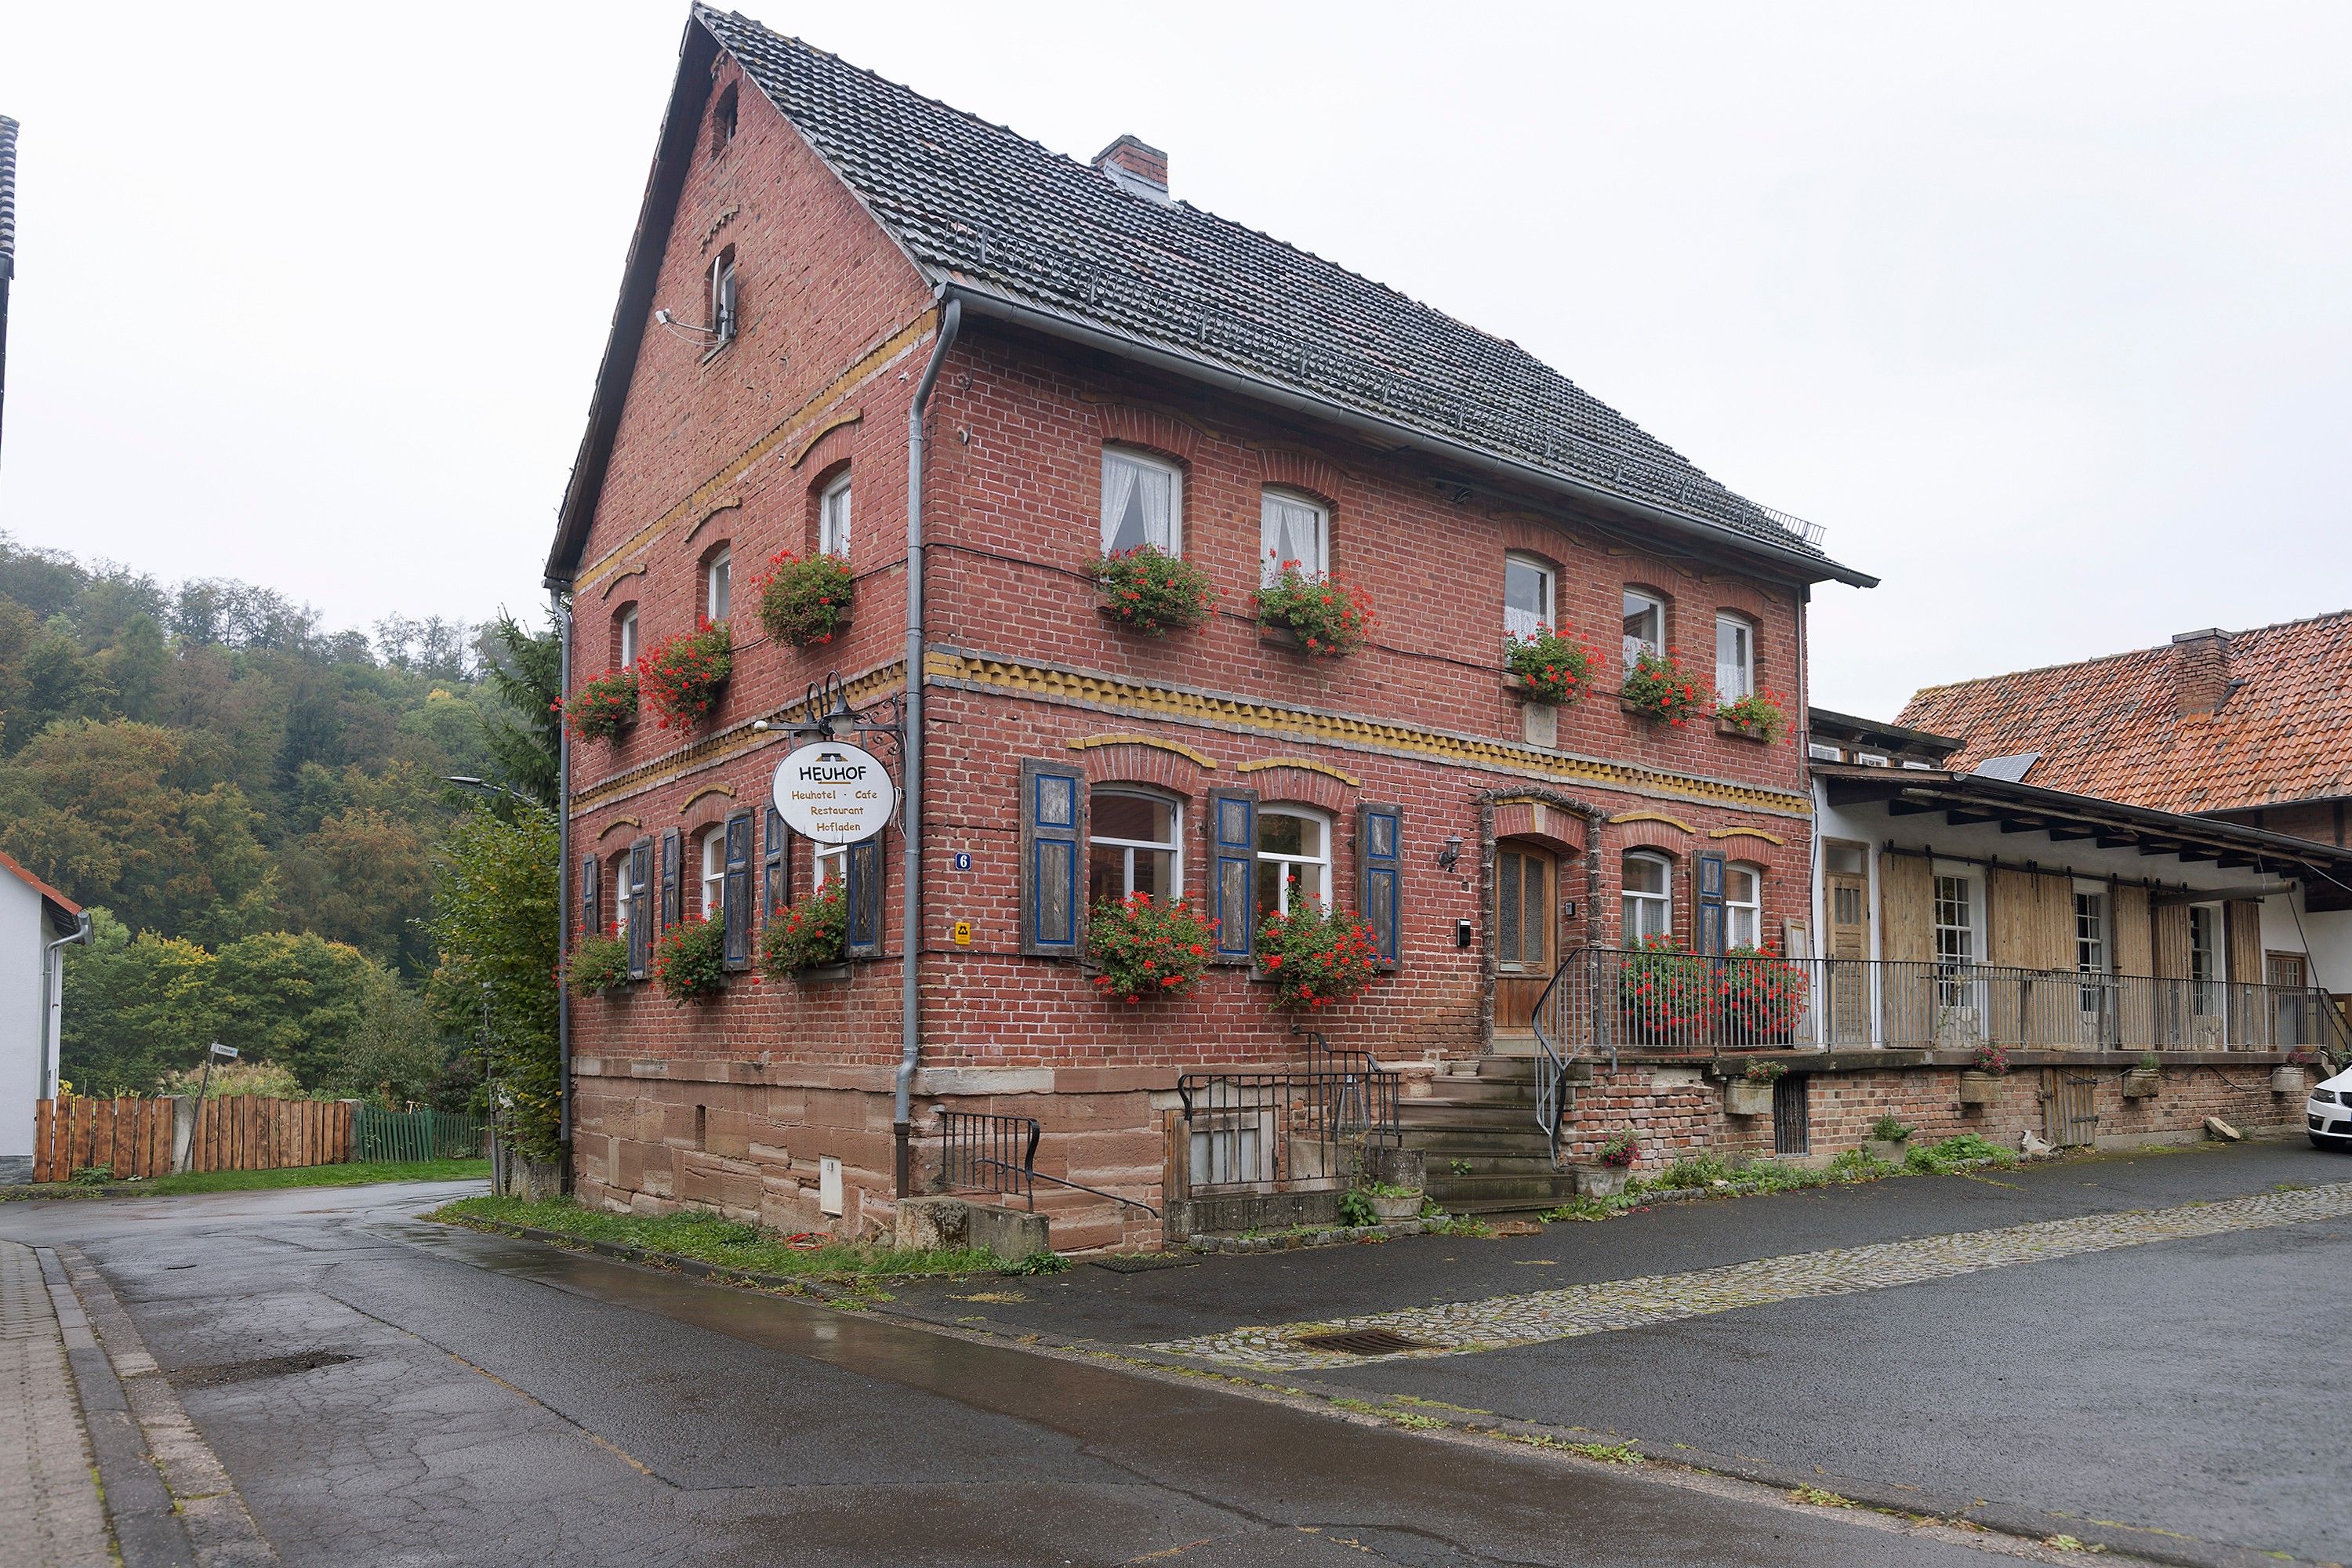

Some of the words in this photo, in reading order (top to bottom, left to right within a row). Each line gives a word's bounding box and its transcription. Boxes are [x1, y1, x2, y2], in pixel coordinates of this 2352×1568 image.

[800, 766, 866, 781] HEUHOF
[792, 790, 836, 800] Heuhotel
[855, 790, 877, 799] Cafe
[810, 806, 864, 815] Restaurant
[816, 822, 861, 832] Hofladen
[960, 855, 967, 868] 6
